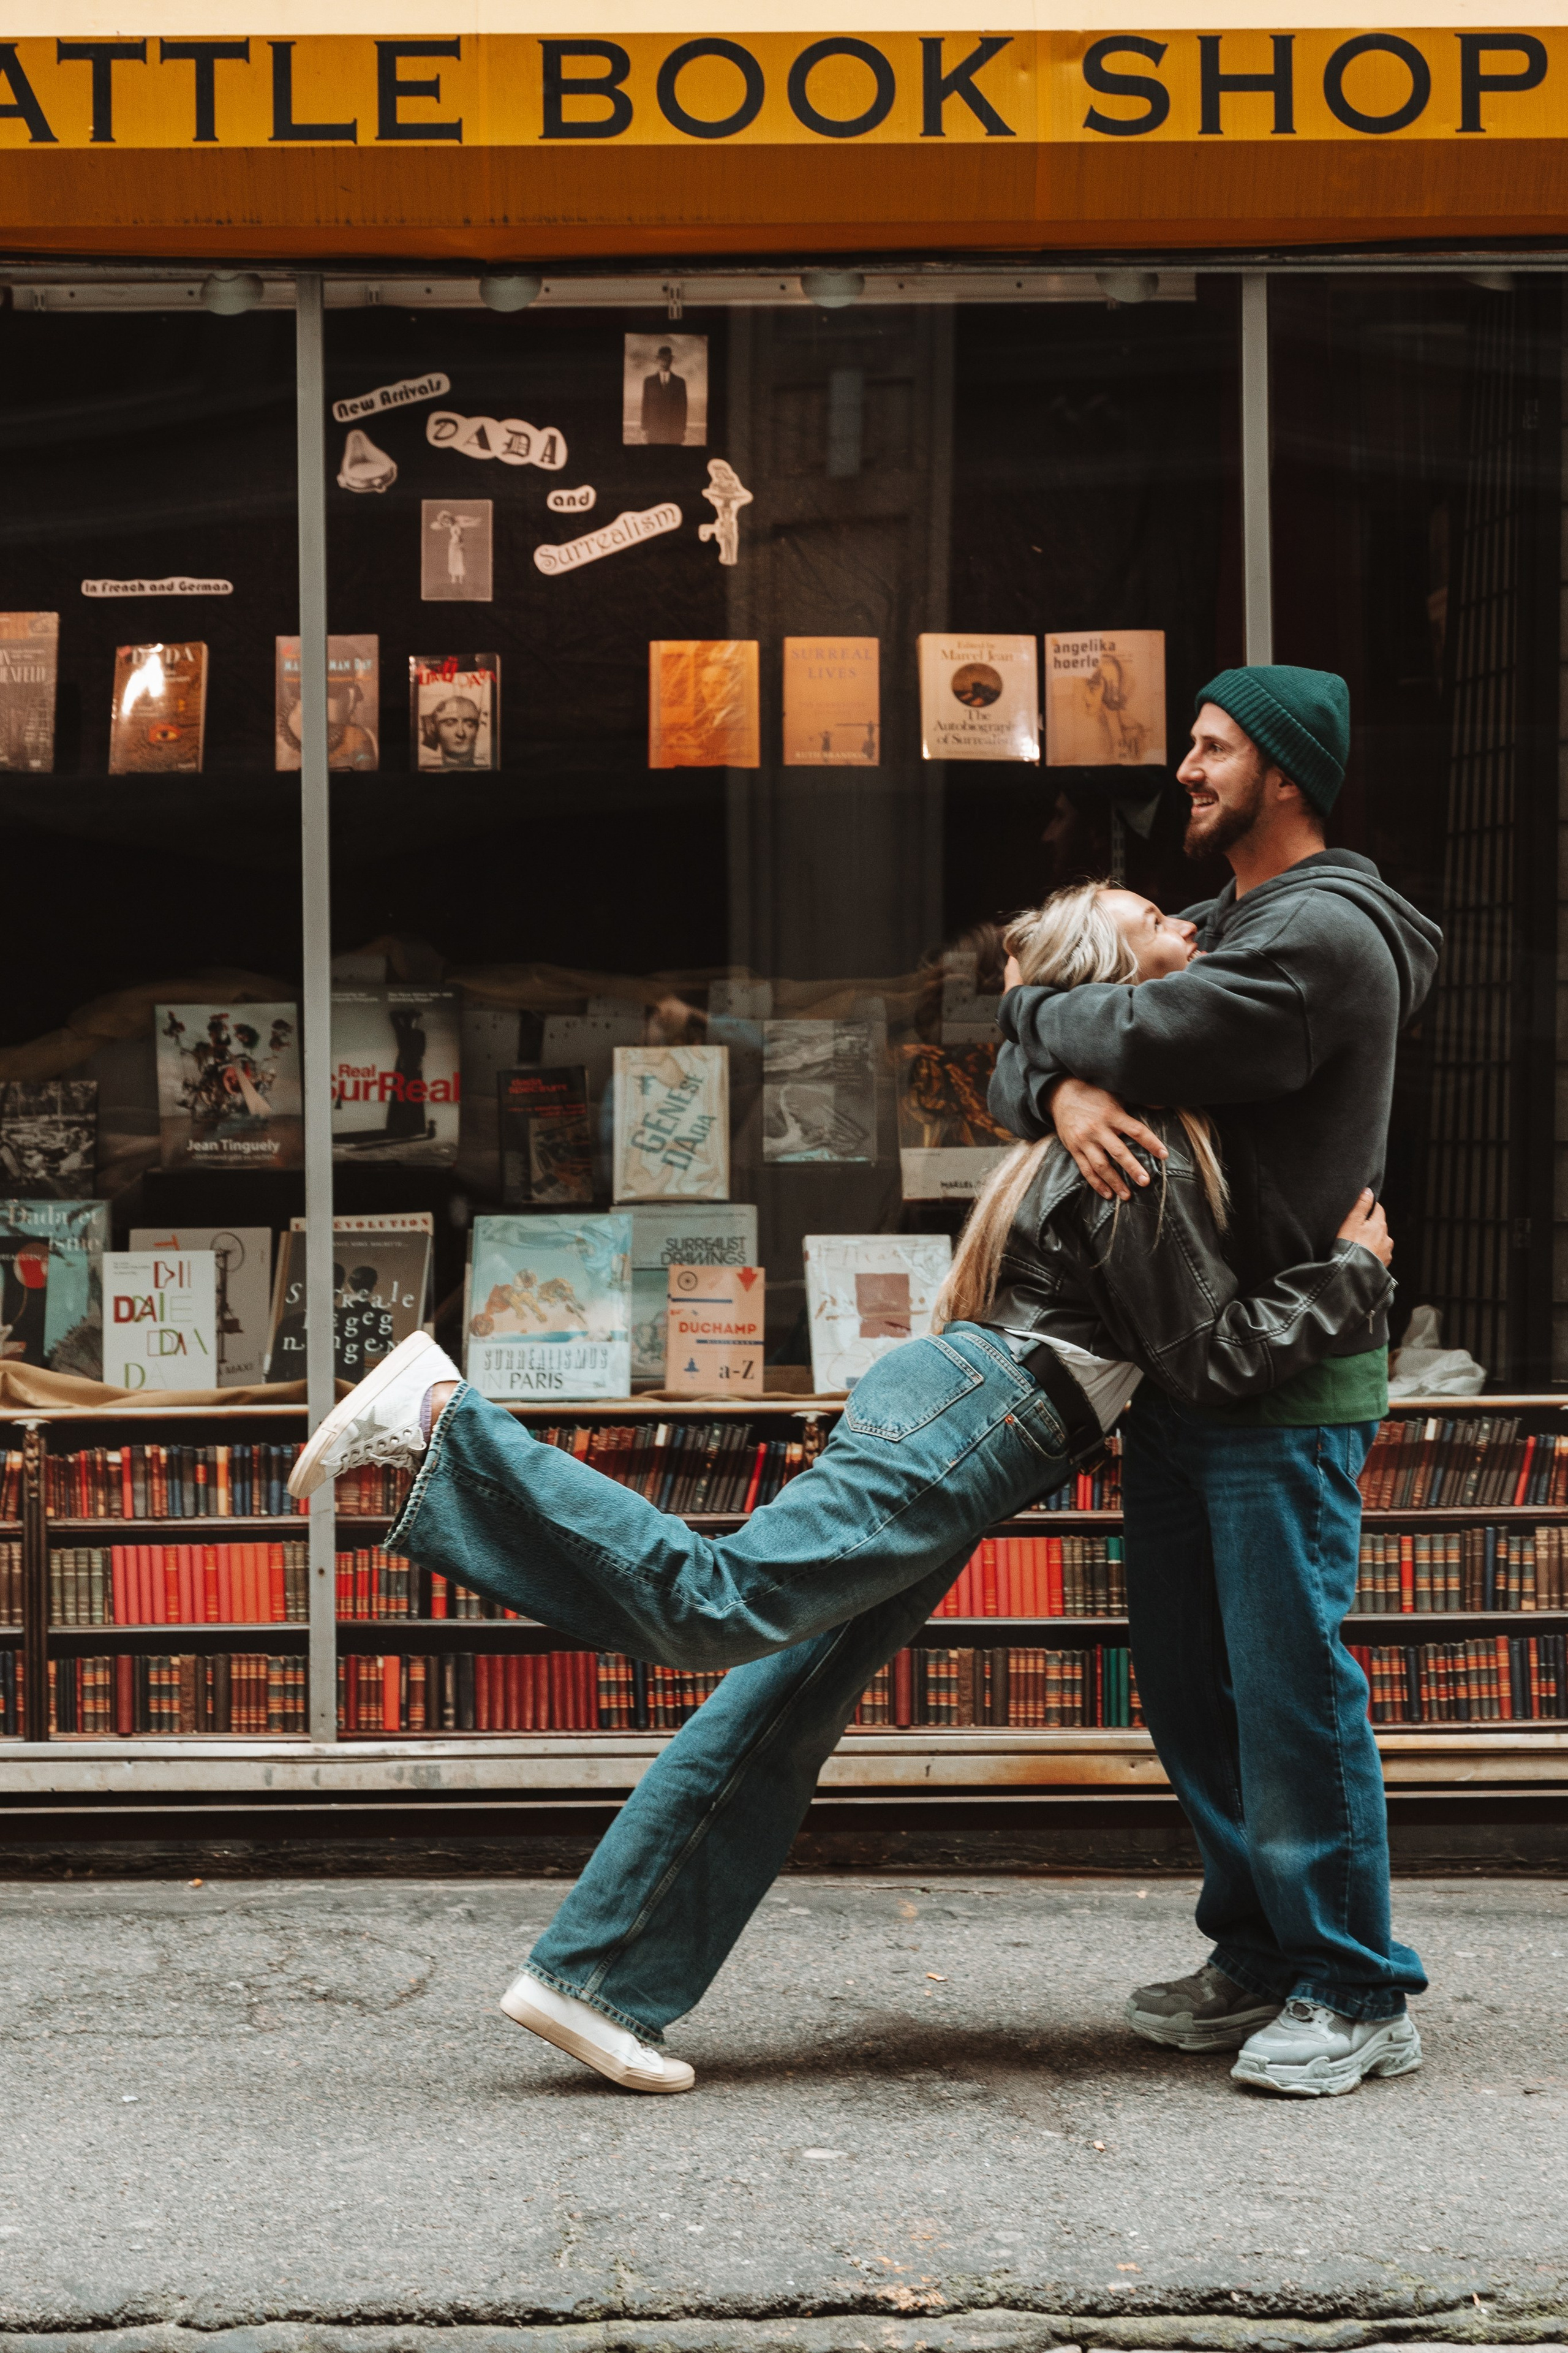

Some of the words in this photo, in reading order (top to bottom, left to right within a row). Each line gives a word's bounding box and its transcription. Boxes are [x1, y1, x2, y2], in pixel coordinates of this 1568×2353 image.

[537, 36, 1017, 139] BOOK
[1082, 33, 1549, 136] SHOP
[337, 398, 375, 419] New
[379, 378, 442, 406] Arrivals
[433, 417, 557, 464] DADA
[552, 491, 590, 507] and
[537, 506, 677, 572] Surrealism
[790, 647, 874, 660] SURREAL
[1054, 638, 1117, 656] angelika
[1054, 655, 1099, 670] hoerle
[807, 666, 859, 679] LIVES
[338, 1064, 377, 1078] Real
[186, 1139, 219, 1152] Jean
[220, 1138, 281, 1154] Tinguely
[661, 1114, 717, 1171] DADA
[665, 1236, 747, 1252] SURREALIST
[660, 1251, 747, 1266] DRAWINGS
[678, 1321, 758, 1335] DUCHAMP
[718, 1359, 755, 1380] a-Z
[509, 1372, 564, 1390] PARIS
